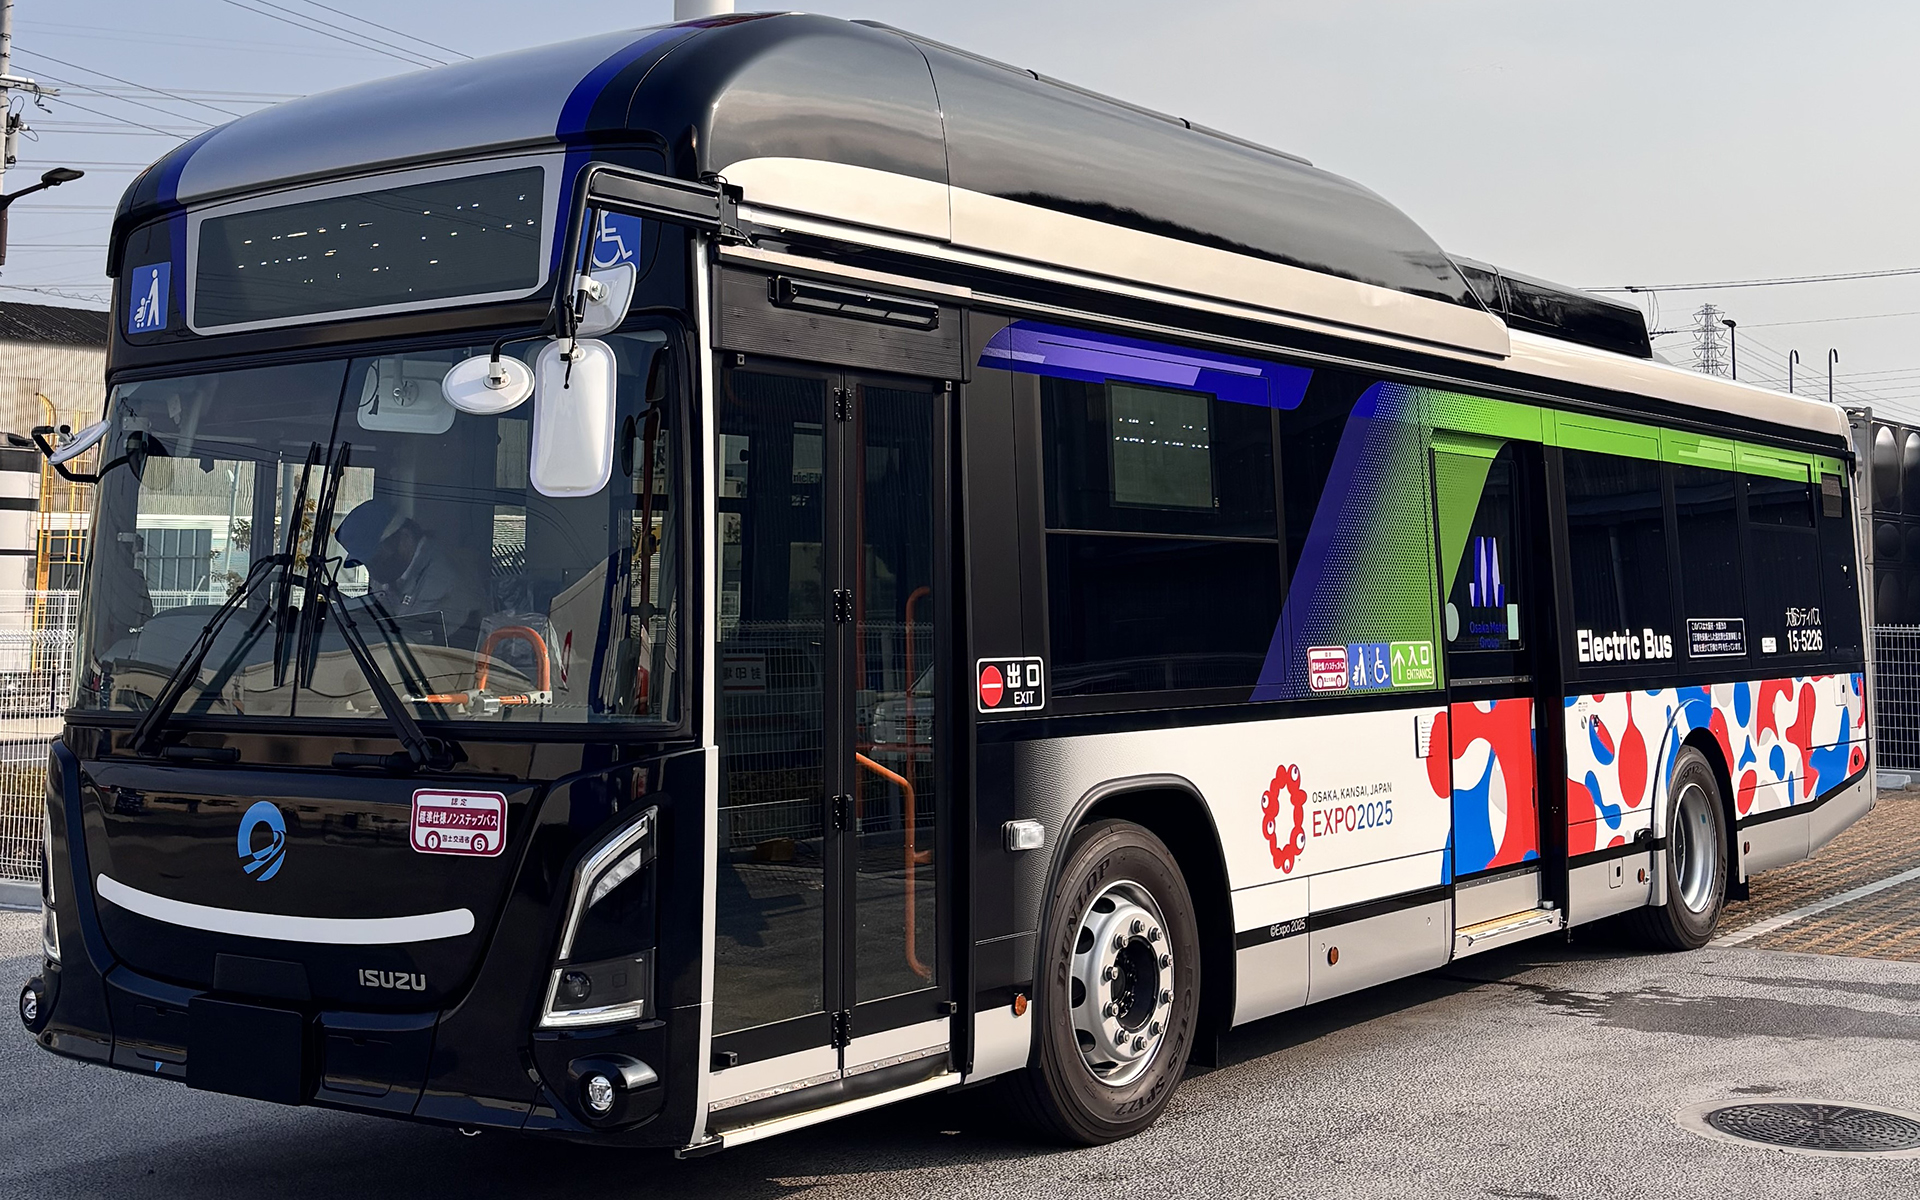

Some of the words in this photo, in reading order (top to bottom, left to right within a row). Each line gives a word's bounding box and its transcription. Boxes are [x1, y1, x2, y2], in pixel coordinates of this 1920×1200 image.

[1577, 629, 1640, 662] Electric
[1643, 628, 1673, 659] Bus
[1787, 629, 1823, 652] 15-5226
[1408, 646, 1429, 667] 入口
[1007, 663, 1040, 688] 出口
[1406, 668, 1433, 680] ENTRANCE
[1014, 691, 1035, 705] EXIT
[1312, 789, 1340, 803] OSAKA,
[1340, 785, 1369, 799] KANSAI,
[1370, 782, 1392, 795] JAPAN
[420, 811, 497, 826] 標準仕様ノンステップバス
[1313, 800, 1393, 837] EXPO2025
[1057, 858, 1110, 988] DUNLOP
[1291, 918, 1306, 932] 2025
[359, 969, 426, 991] ISUZU
